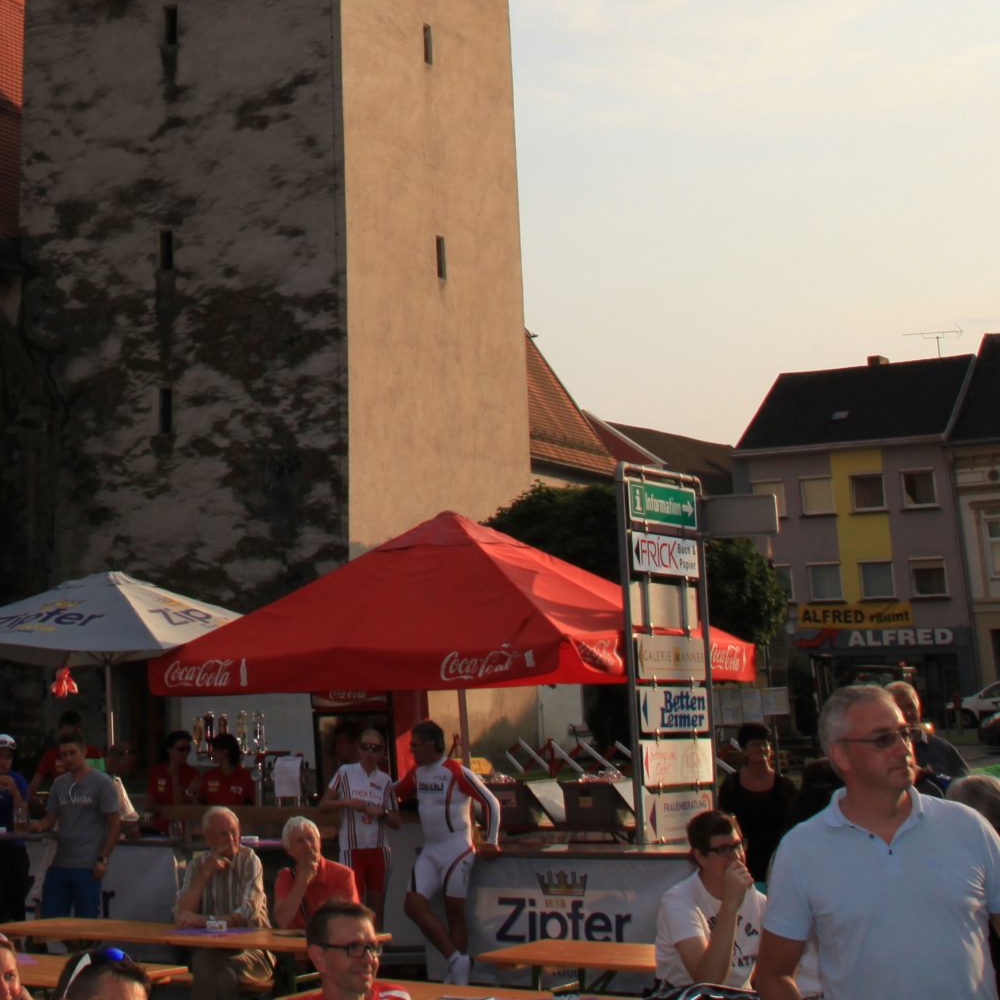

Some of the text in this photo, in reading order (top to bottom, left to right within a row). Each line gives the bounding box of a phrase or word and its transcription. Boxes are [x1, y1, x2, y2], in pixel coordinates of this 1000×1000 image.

[645, 491, 682, 516] Information
[148, 608, 212, 626] Zip
[802, 609, 865, 624] ALFRED
[848, 628, 953, 647] ALFRED
[164, 658, 233, 688] Coca-Cola
[663, 690, 705, 713] Betten
[659, 706, 704, 728] Leimer
[495, 897, 631, 942] Zipfer
